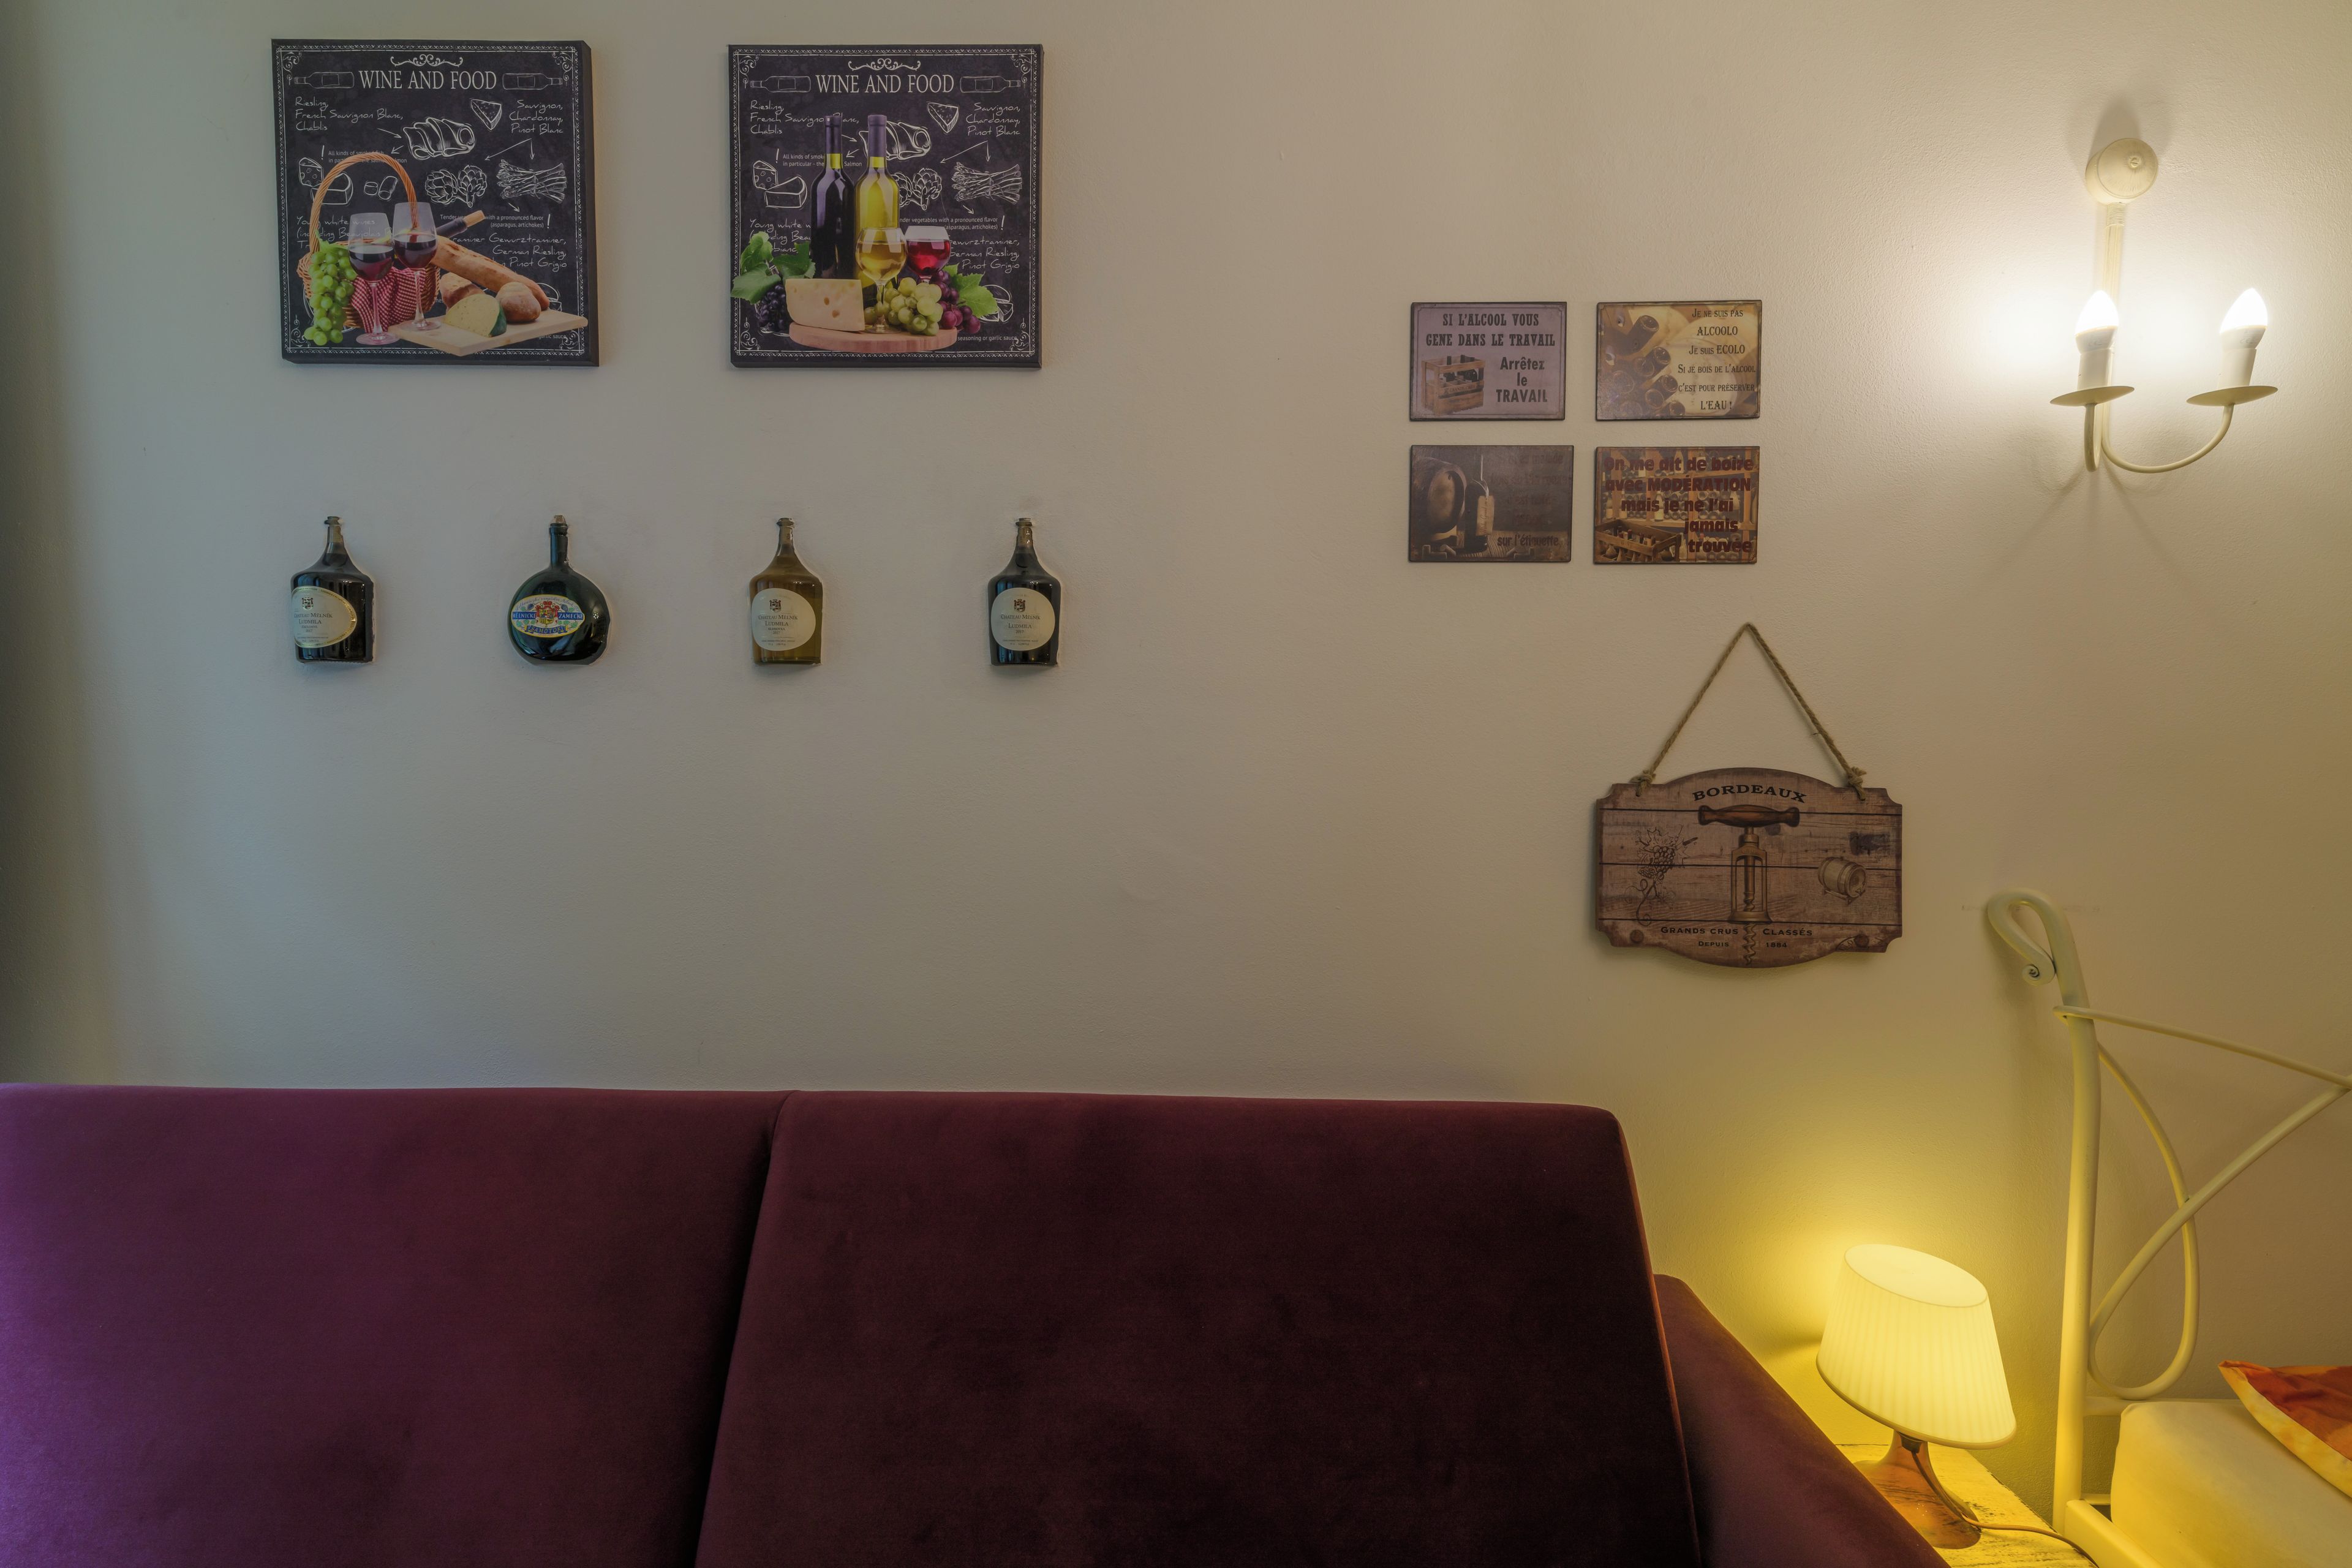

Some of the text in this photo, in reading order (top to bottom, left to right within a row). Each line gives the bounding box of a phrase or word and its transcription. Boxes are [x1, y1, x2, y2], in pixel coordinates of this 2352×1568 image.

[359, 70, 497, 90] WINE AND FOOD
[815, 75, 955, 94] WINE AND FOOD
[295, 96, 329, 111] Riesling,
[750, 100, 784, 115] Riesling,
[974, 102, 1020, 116] Sauvignon,
[295, 108, 404, 124] French Sauvignon Blanc,
[510, 99, 564, 124] Sauvignon, Chardonnay,
[296, 121, 328, 132] Chablis
[750, 112, 781, 123] French
[784, 113, 824, 127] Sauvigno
[966, 114, 1020, 127] Chardonnay,
[511, 123, 564, 135] Pinot Blanc
[750, 124, 783, 135] Chablis
[968, 126, 1020, 137] Pinot Blanc
[324, 215, 349, 226] white
[750, 219, 774, 233] Young
[777, 217, 802, 229] white
[492, 245, 567, 260] German Riesling,
[985, 246, 1020, 262] Riesling,
[509, 256, 534, 268] Pinot
[537, 257, 568, 273] Grigio
[962, 258, 1020, 274] Pinot Grigio
[1442, 314, 1539, 326] SI L'ALCOOL VOUS
[1730, 309, 1744, 317] PAS
[1696, 326, 1738, 336] ALCOOLO
[1426, 334, 1556, 347] GENE DANS LE TRAVAIL
[1716, 344, 1746, 355] ECOLO
[1499, 356, 1545, 371] Arrêtez
[1517, 372, 1528, 387] le
[1496, 389, 1548, 403] TRAVAIL
[1604, 456, 1754, 471] On me dit de boire
[1604, 474, 1751, 491] avec MODÉRATION
[1621, 497, 1734, 514] mais je ne l'ai
[1684, 518, 1738, 534] jamais
[1497, 537, 1513, 546] sur
[1687, 537, 1753, 552] trouvée
[1692, 784, 1807, 804] BORDEAUX
[1660, 927, 1705, 935] GRANDS
